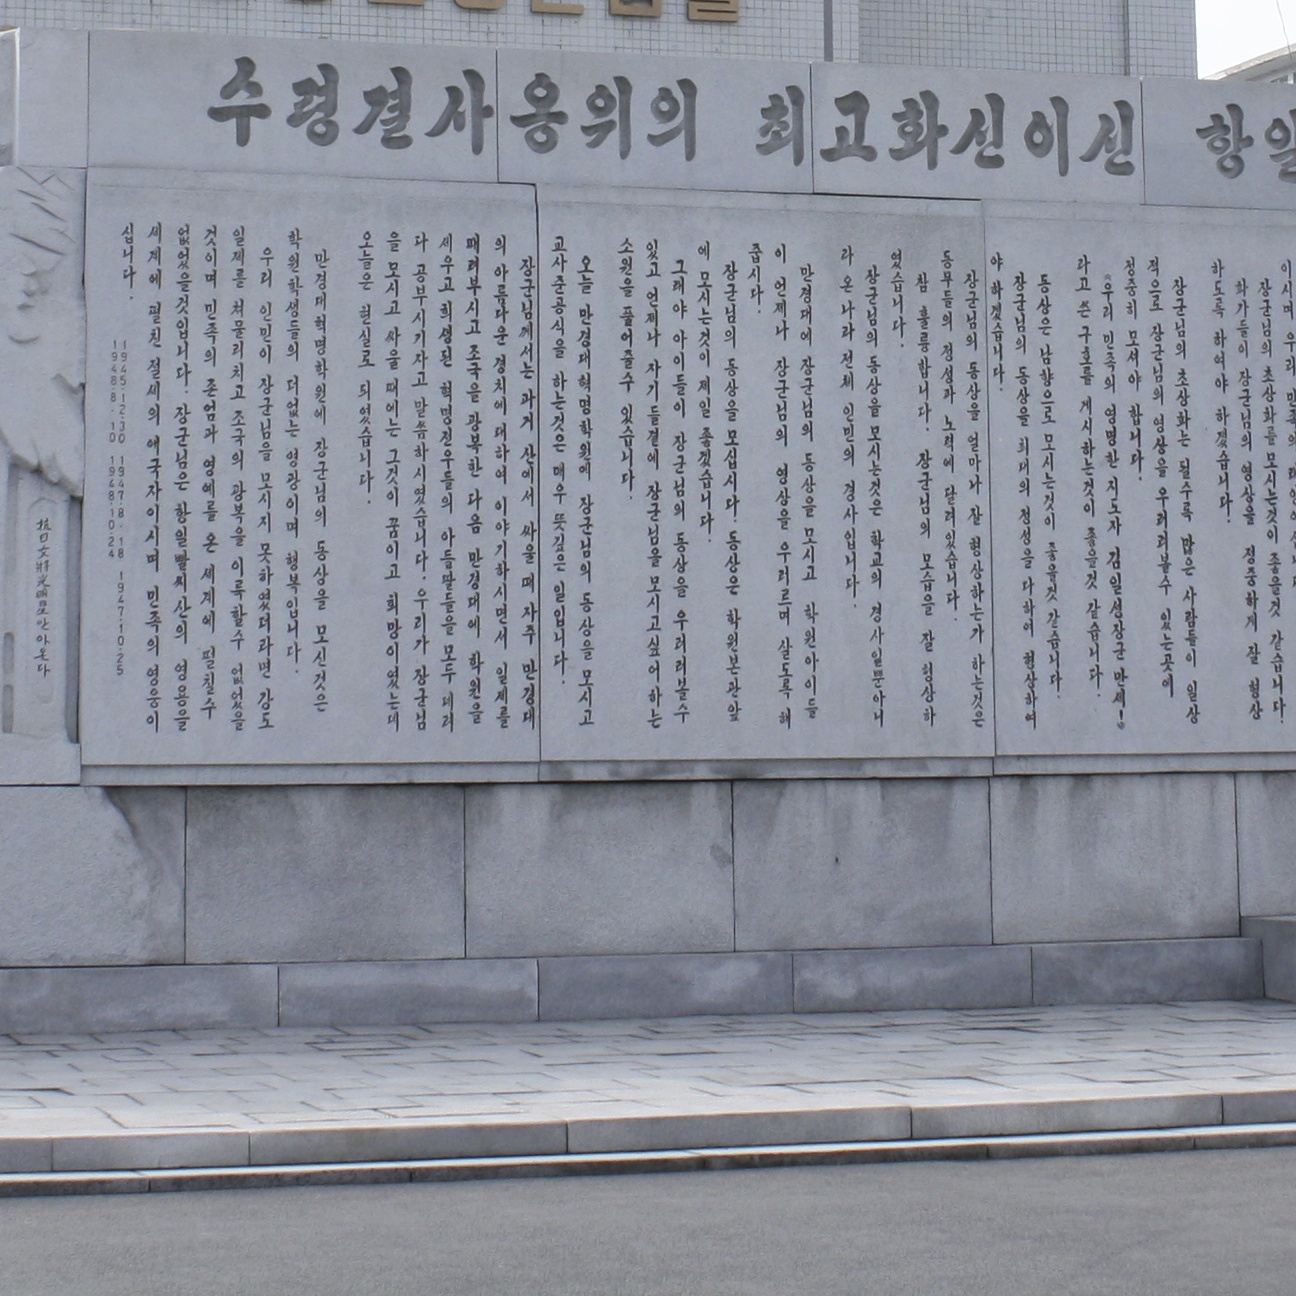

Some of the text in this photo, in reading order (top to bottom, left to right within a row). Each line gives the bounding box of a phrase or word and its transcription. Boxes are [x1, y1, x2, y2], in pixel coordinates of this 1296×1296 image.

[759, 87, 1138, 177] 최고화신이신
[174, 223, 192, 491] 없었을것입니다. 장군님은
[204, 224, 218, 367] 것이며 민족의
[231, 225, 247, 471] 일제를 조국의
[358, 231, 375, 368] 오늘은 현실로
[493, 263, 510, 485] 아름다운 대하여
[550, 235, 568, 453] 교사준공식을 하는것은
[617, 238, 635, 393] 소원을 풀어줄수
[697, 271, 713, 419] 모시는것이 제일
[722, 260, 739, 422] 장군님의 동상을
[773, 276, 790, 447] 언제나 장군님의
[799, 263, 815, 442] 만경대에 장군님의
[865, 264, 882, 415] 장군님의 동상을
[941, 250, 956, 405] 동무들의 정성과
[964, 269, 981, 421] 장군님의 동상을
[1013, 271, 1030, 427] 장군님의 동상을
[1036, 273, 1056, 424] 동상은 남향으로
[1078, 325, 1094, 386] 구호를
[1124, 256, 1145, 481] 정중히 합니다.
[1172, 276, 1191, 448] 장군님의 초상화는
[1235, 277, 1252, 452] 화가들이 장군님의
[1258, 278, 1277, 446] 장군님의 초상화를
[1281, 259, 1294, 320] 이시며
[145, 222, 162, 573] 세계에 애국자이시며
[258, 301, 274, 462] 인민이 장군님을
[285, 227, 303, 538] 학원학생들의 영광이며
[384, 261, 401, 507] 모시고 그것이
[438, 233, 457, 636] 세우고 아들딸들을
[519, 255, 535, 507] 장군님께서는 산에서
[577, 303, 594, 584] 만경대혁명학원에 장군님의
[645, 286, 662, 568] 언제나 장군님을
[672, 329, 688, 521] 아이들이 장군님의
[916, 305, 933, 539] 훌륭합니다. 장군님의
[1103, 330, 1122, 536] 민족의 지도자
[1213, 328, 1233, 523] 하여야 하겠습니다.
[313, 437, 329, 611] 장군님의 동상을
[466, 344, 484, 638] 조국을 만경대에
[843, 402, 860, 608] 인민의 경사입니다.
[1150, 322, 1175, 698] 장군님의 있는곳에
[413, 588, 429, 655] 우리가
